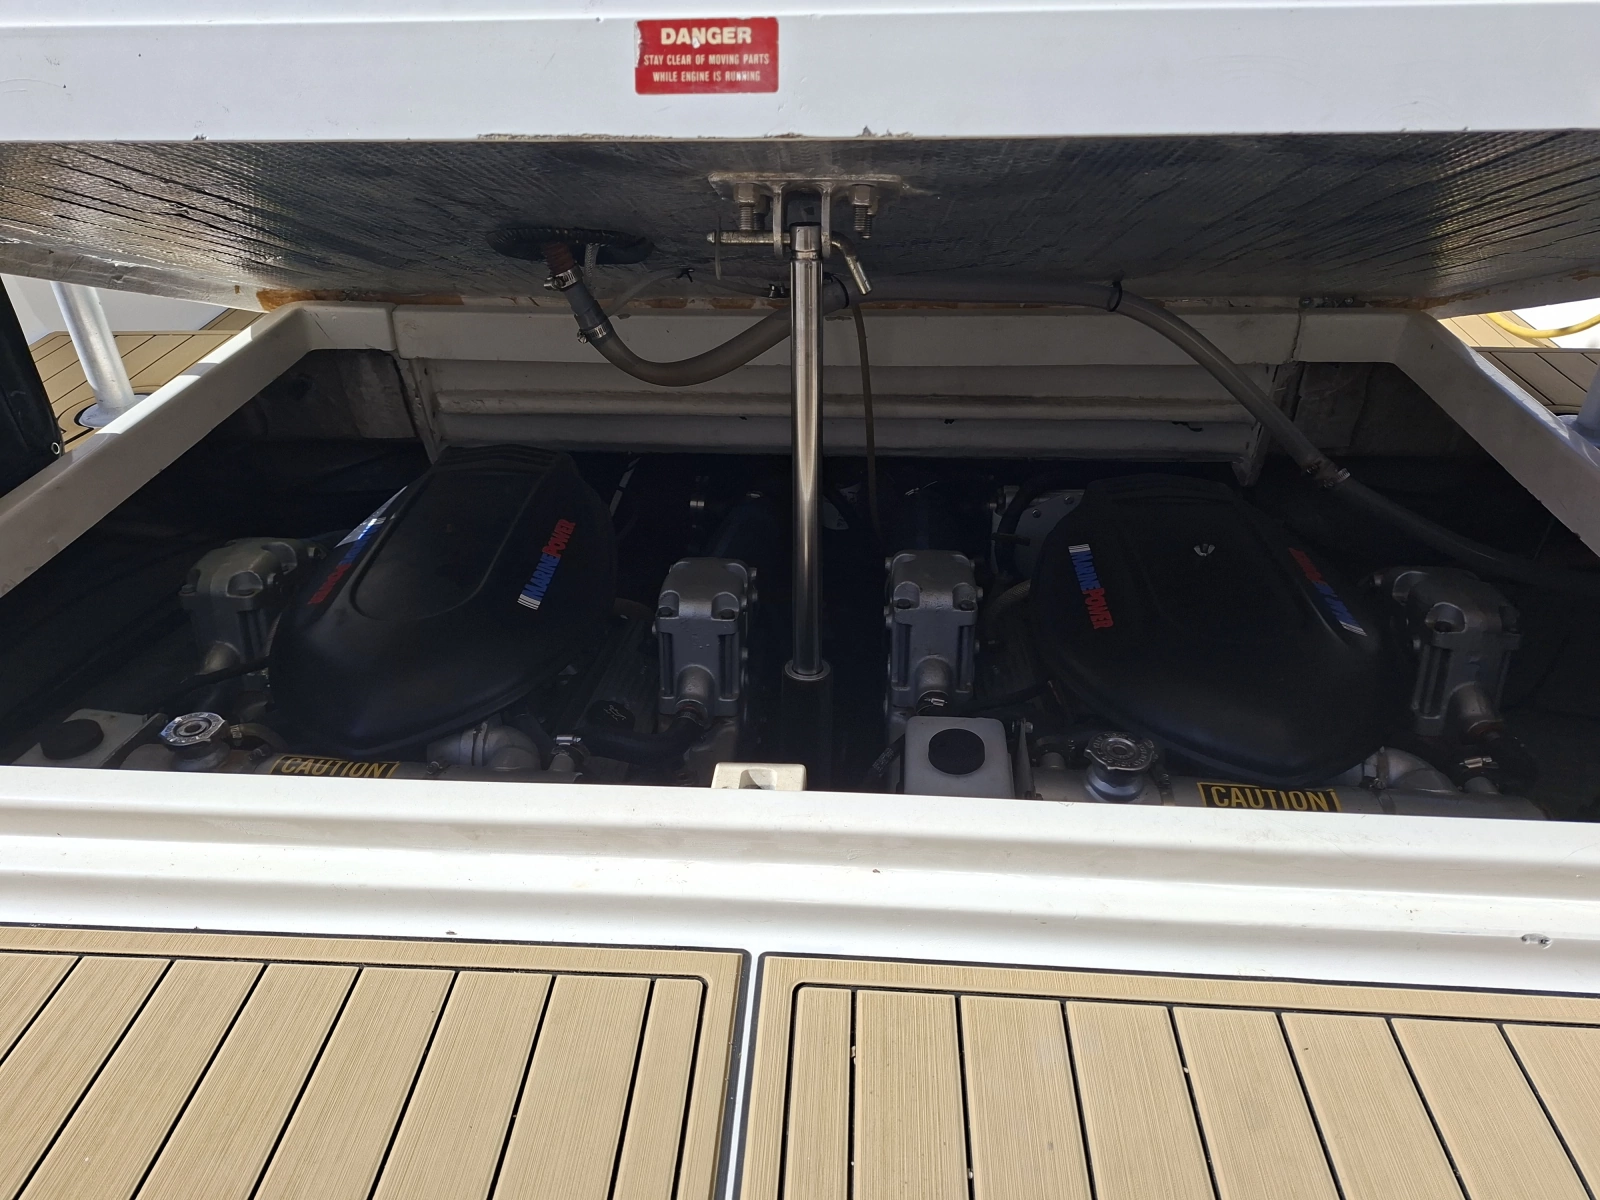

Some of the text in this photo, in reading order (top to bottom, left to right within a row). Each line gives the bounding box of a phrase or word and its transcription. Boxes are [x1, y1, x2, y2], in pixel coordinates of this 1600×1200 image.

[661, 26, 752, 45] DANGER
[644, 53, 769, 66] STAY CLEAR OF MOVING PARTS
[653, 70, 761, 82] WHILE ENGINE IS RUNNING
[280, 757, 388, 778] CAUTION
[1210, 785, 1330, 812] CAUTION
